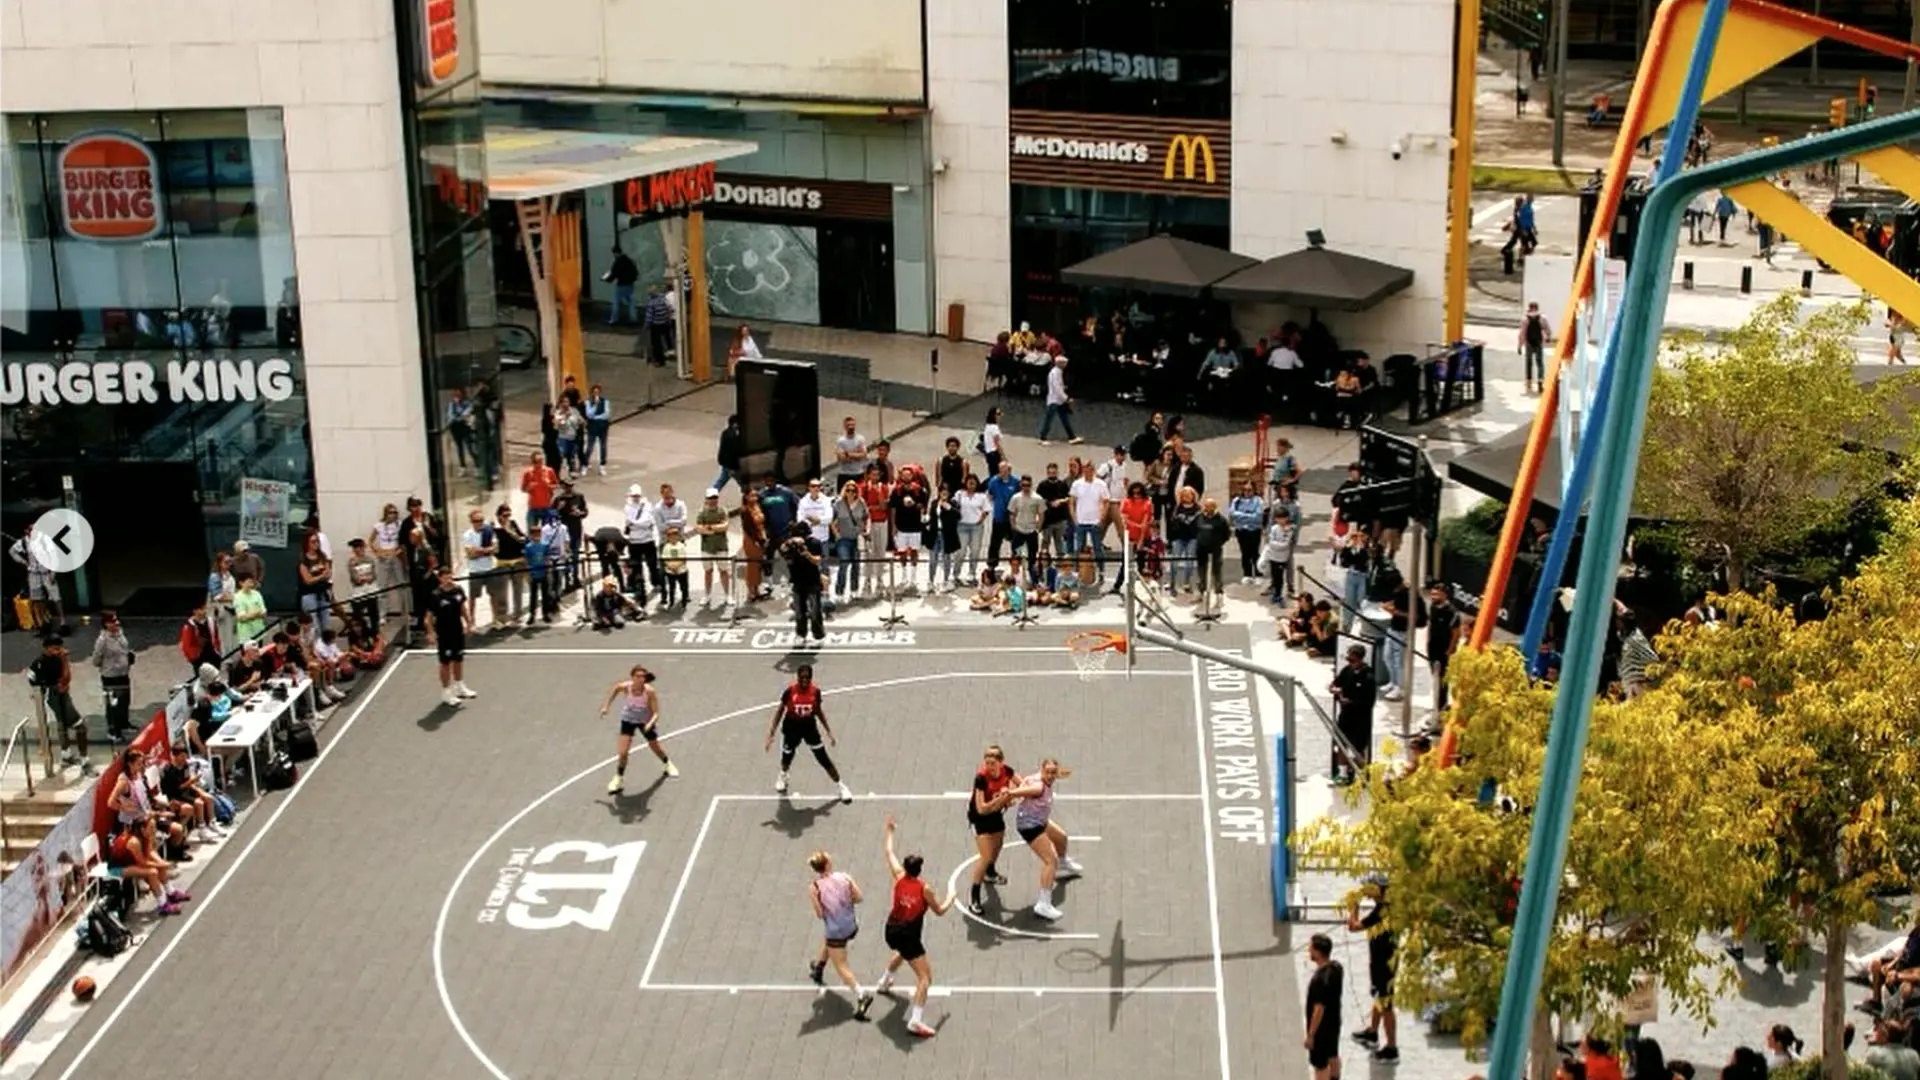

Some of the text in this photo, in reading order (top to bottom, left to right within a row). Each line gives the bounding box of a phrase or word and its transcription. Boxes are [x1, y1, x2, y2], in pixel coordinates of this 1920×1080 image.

[1014, 135, 1149, 162] McDonald's
[64, 168, 153, 191] BURGER
[67, 191, 155, 219] KING
[698, 180, 822, 209] Donald's
[0, 359, 293, 405] URGER KING
[669, 628, 746, 644] TIME
[1210, 697, 1256, 748] WORK
[1215, 755, 1262, 800] PAYS
[1218, 806, 1266, 845] OFF
